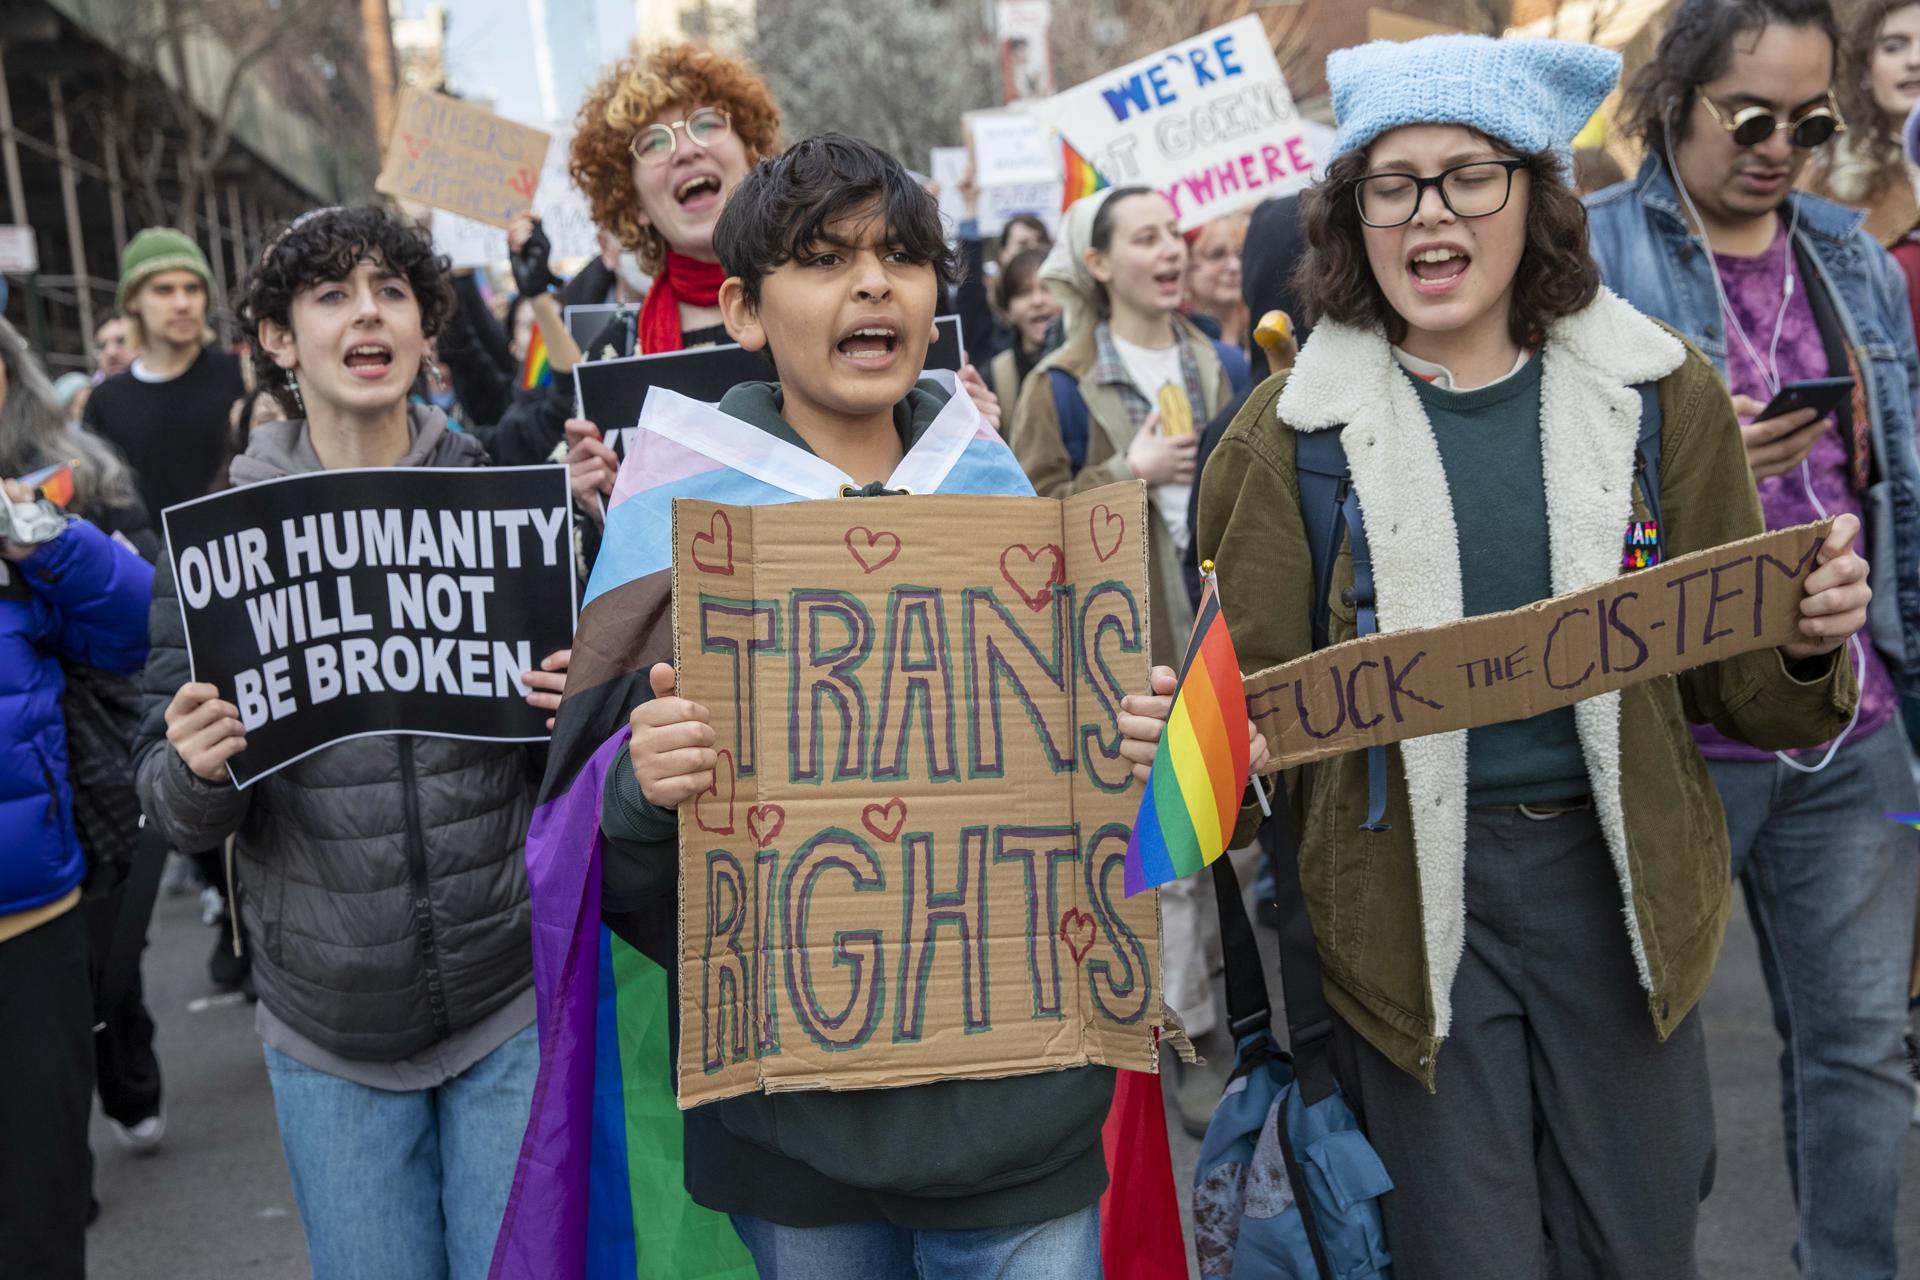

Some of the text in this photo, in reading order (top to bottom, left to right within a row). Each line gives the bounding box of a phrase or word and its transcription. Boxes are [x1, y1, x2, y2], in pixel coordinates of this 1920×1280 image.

[1092, 78, 1291, 182] OT GOING
[1156, 136, 1315, 219] YWHERE
[179, 506, 567, 610] OUR HUMANITY
[245, 572, 495, 656] WILL NOT
[1245, 537, 1825, 739] FUCK THE CIS-TEM
[233, 635, 533, 732] BE BROKEN
[699, 579, 1143, 794] TRANS
[704, 821, 1152, 1076] RIGHTS
